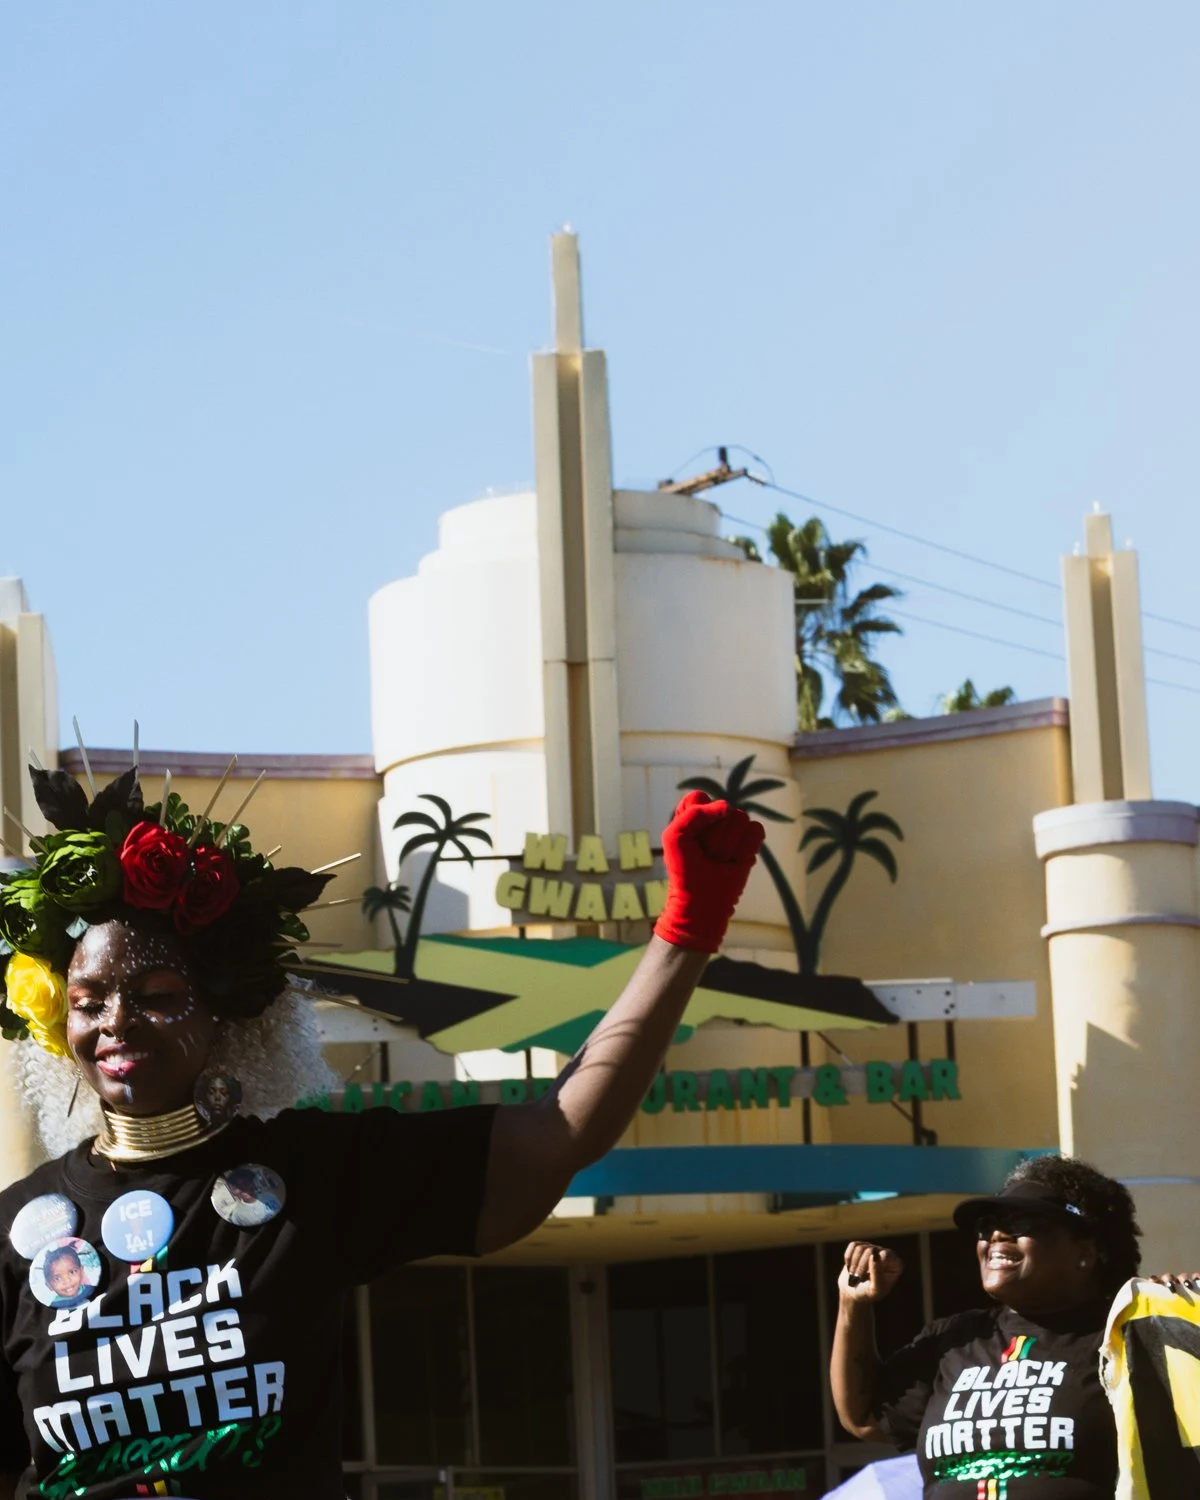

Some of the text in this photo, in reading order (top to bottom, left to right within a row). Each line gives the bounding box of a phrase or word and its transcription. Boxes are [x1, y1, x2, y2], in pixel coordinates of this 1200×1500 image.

[523, 829, 654, 873] WAH
[812, 1062, 849, 1107] &
[865, 1058, 962, 1103] BAR
[119, 1199, 153, 1222] ICE
[48, 1257, 243, 1336] BLACK
[53, 1307, 246, 1394] LIVES
[951, 1359, 1068, 1393] BLACK
[33, 1360, 286, 1453] MATTER
[943, 1387, 1055, 1421] LIVES
[925, 1416, 1075, 1459] MATTER
